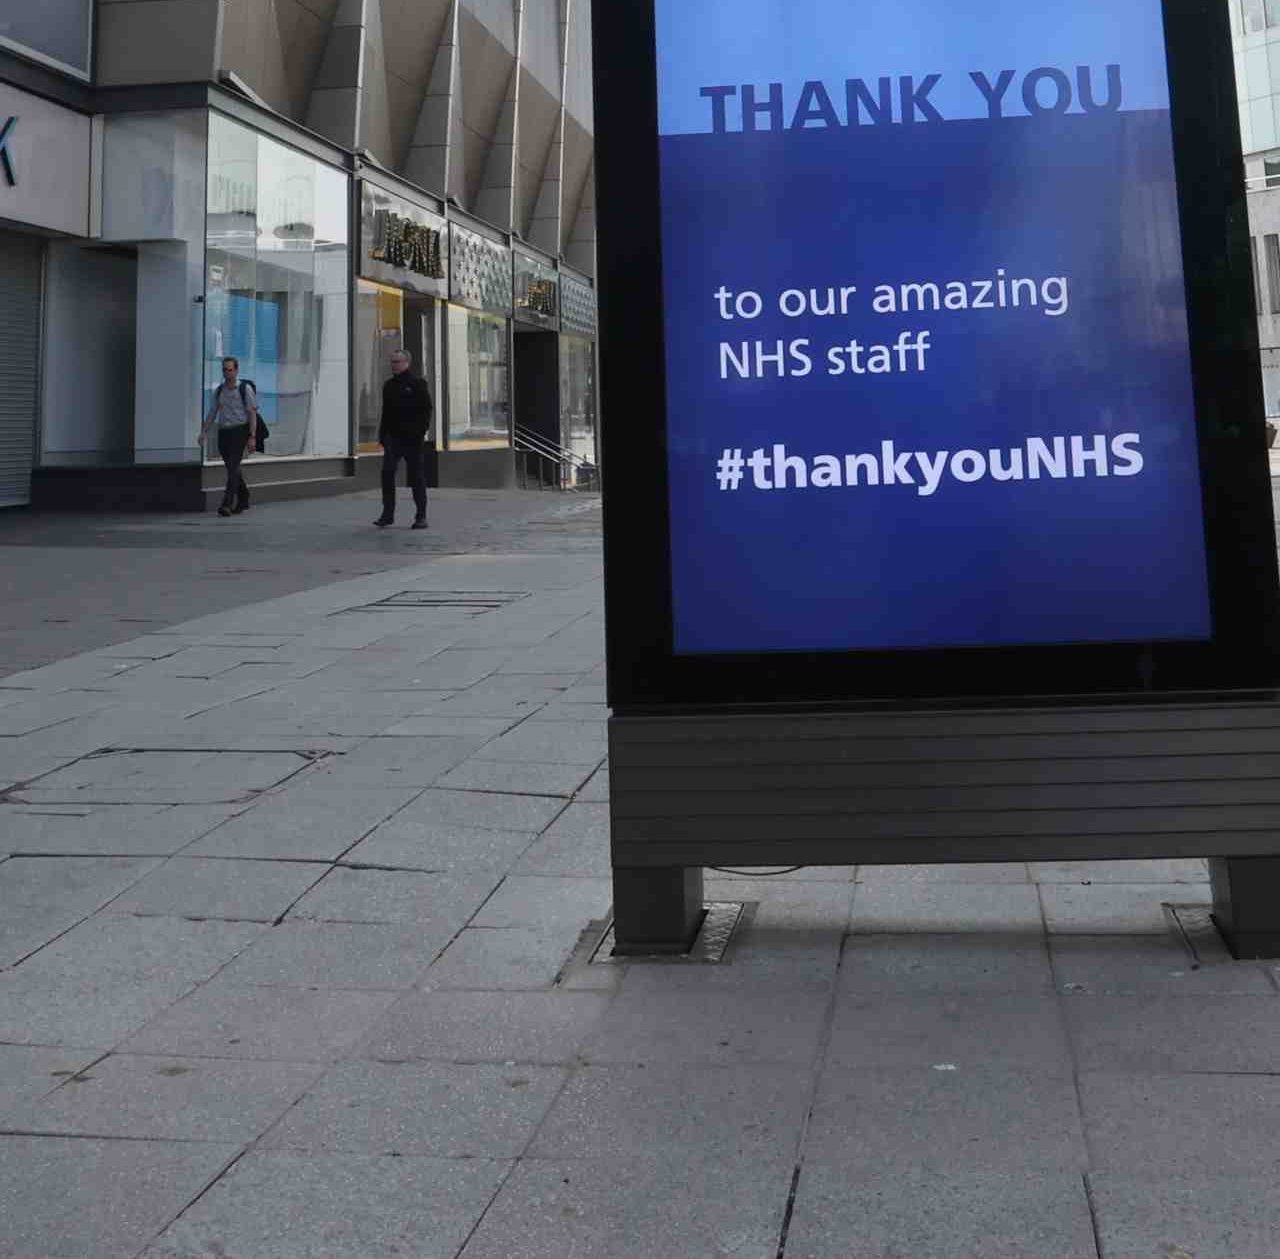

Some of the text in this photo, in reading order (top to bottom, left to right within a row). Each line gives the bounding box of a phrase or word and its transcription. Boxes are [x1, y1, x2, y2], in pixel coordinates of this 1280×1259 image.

[699, 64, 1122, 134] THANK YOU
[714, 268, 1069, 320] to our amazing
[720, 331, 931, 379] NHS staff
[716, 433, 1144, 496] #thankyouNHS
